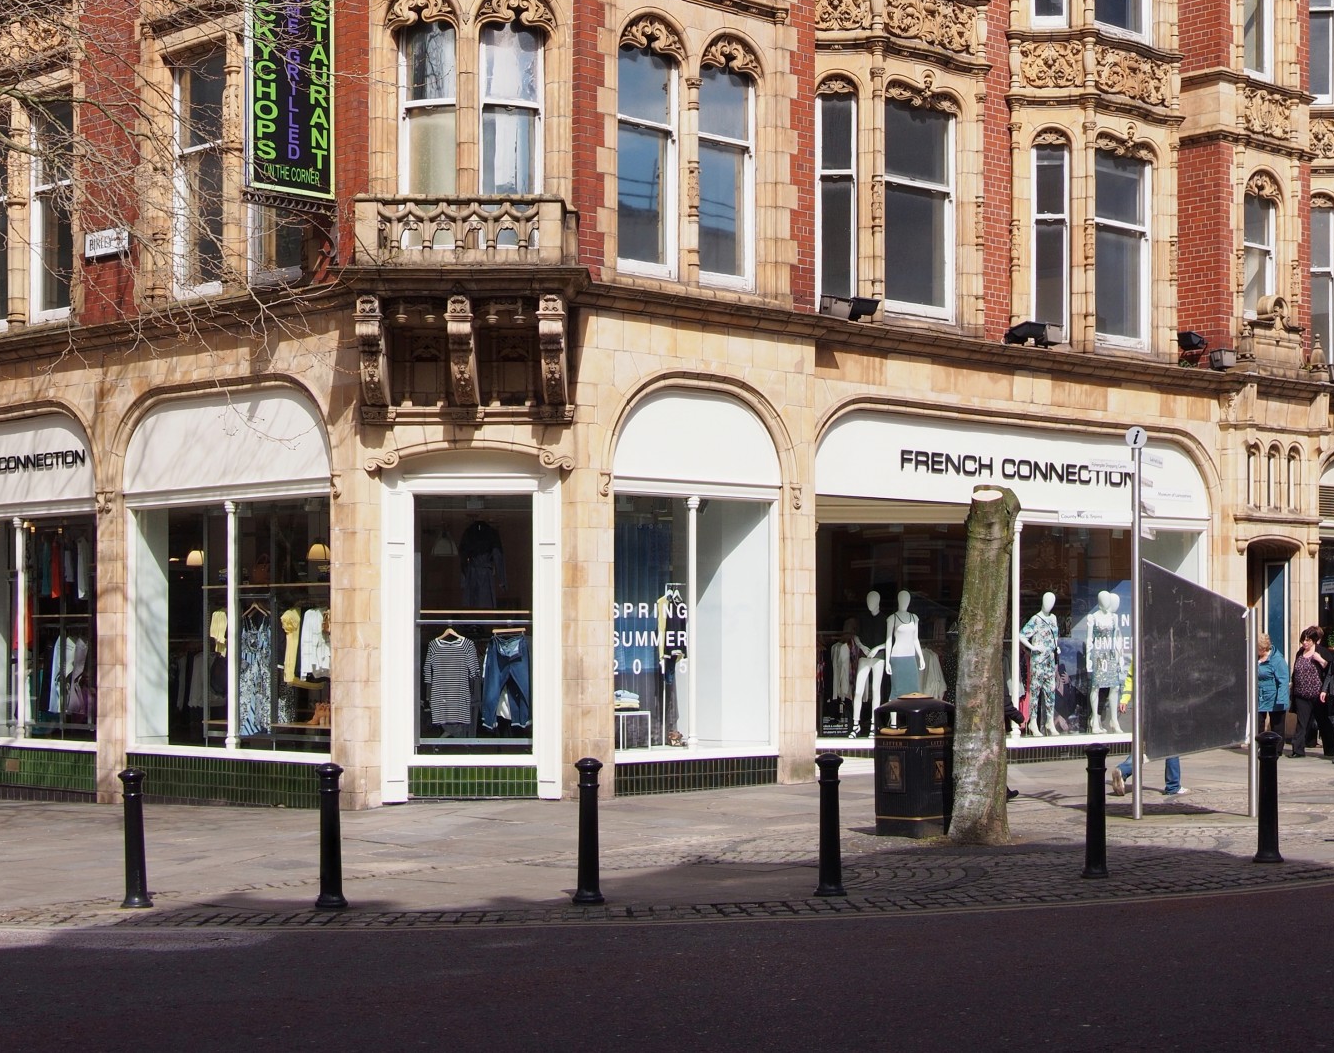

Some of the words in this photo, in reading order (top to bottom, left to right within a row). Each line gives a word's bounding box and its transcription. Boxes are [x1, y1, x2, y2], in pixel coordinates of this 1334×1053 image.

[287, 49, 300, 160] GRILLED
[276, 166, 289, 181] THE
[291, 168, 320, 185] CORNER
[900, 449, 994, 477] FRENCH
[614, 602, 687, 619] SPRING
[614, 630, 687, 647] SUMMER
[614, 658, 687, 675] 2015
